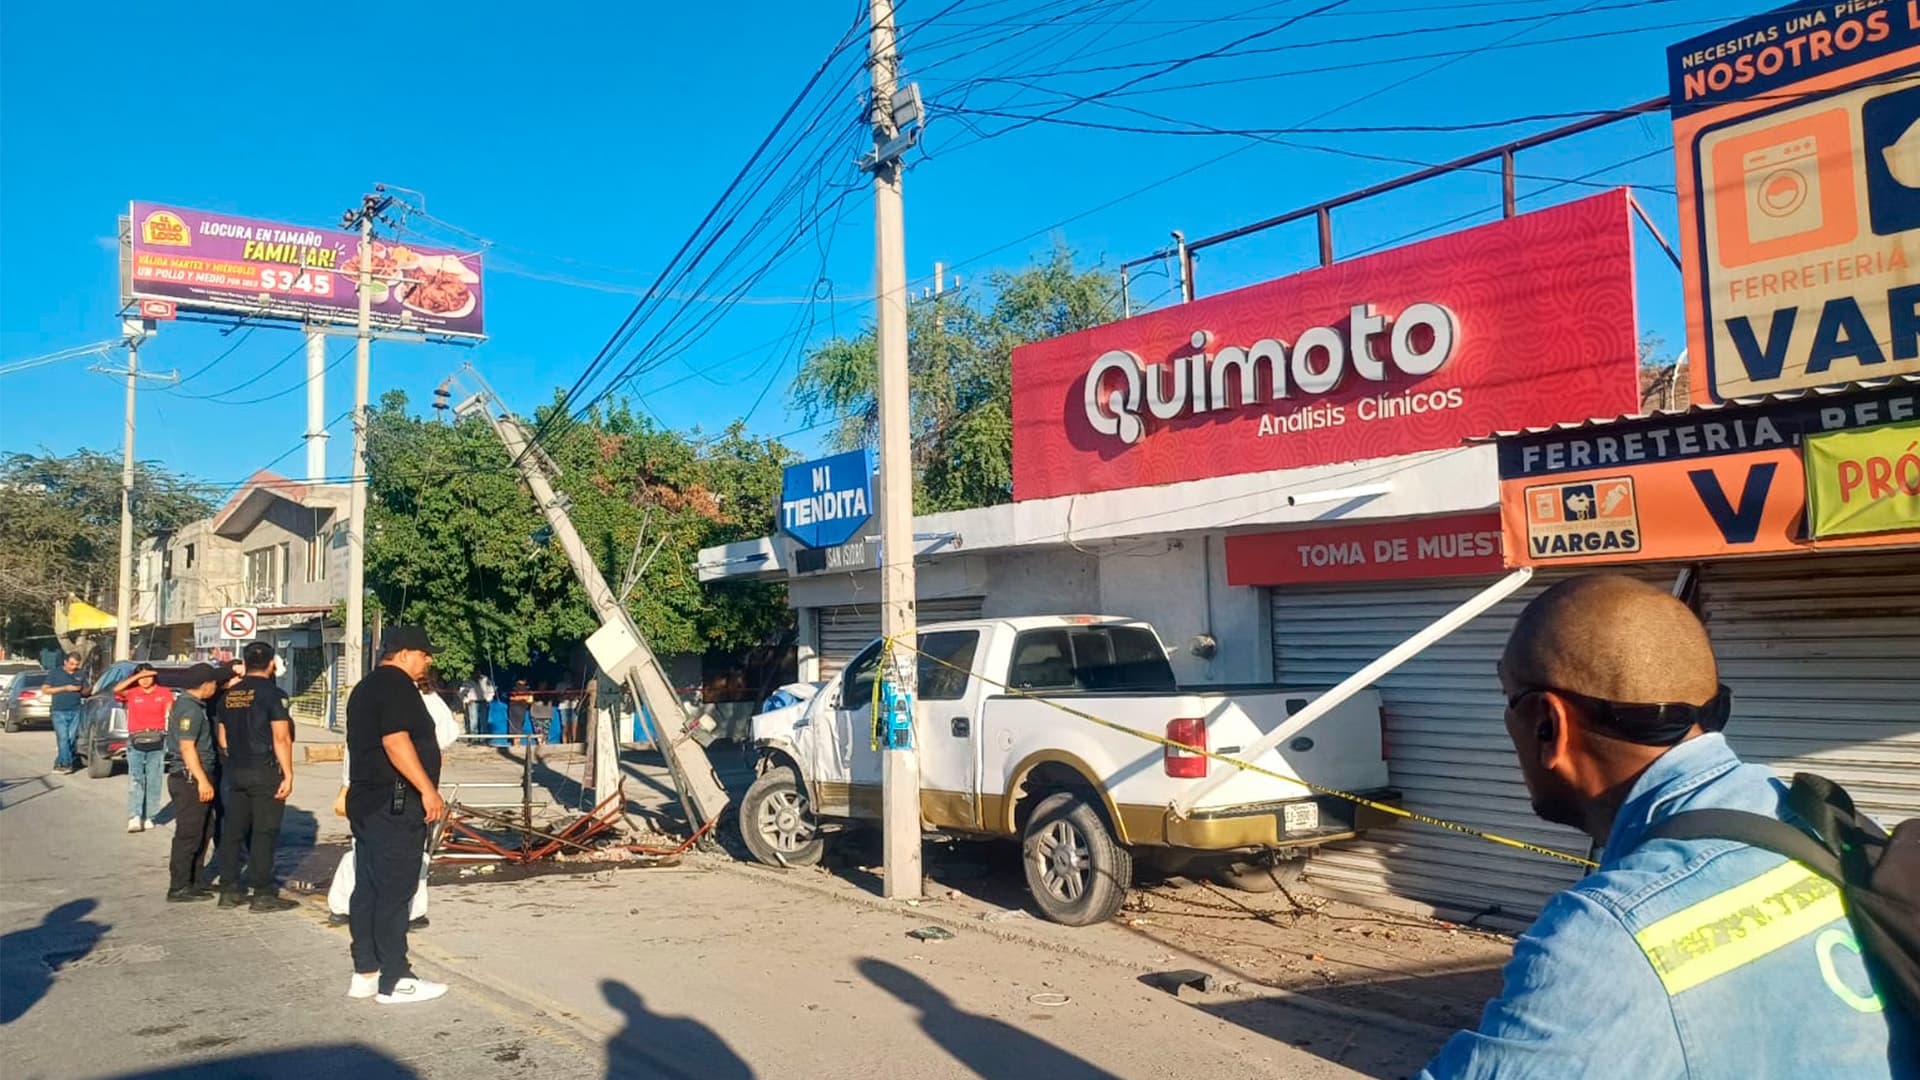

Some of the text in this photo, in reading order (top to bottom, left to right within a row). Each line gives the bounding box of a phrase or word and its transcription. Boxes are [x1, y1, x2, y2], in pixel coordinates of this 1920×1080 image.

[1682, 0, 1885, 69] NECESITAS UNA PIEZ
[1683, 9, 1890, 101] NOSOTROS
[200, 221, 323, 247] ¡LOCURA EN TAMAÑO
[137, 266, 153, 277] UN
[155, 267, 184, 280] POLLO
[187, 271, 194, 280] Y
[195, 271, 226, 285] MEDIO
[260, 268, 331, 295] $345
[1729, 245, 1909, 303] FERRETERIA
[1084, 301, 1458, 444] Quimoto
[1257, 386, 1464, 438] Análisis Clínicos
[811, 465, 831, 493] MI
[782, 487, 867, 529] TIENDITA
[1297, 541, 1366, 568] TOMA
[1373, 538, 1409, 563] DE
[1532, 529, 1635, 554] VARGAS
